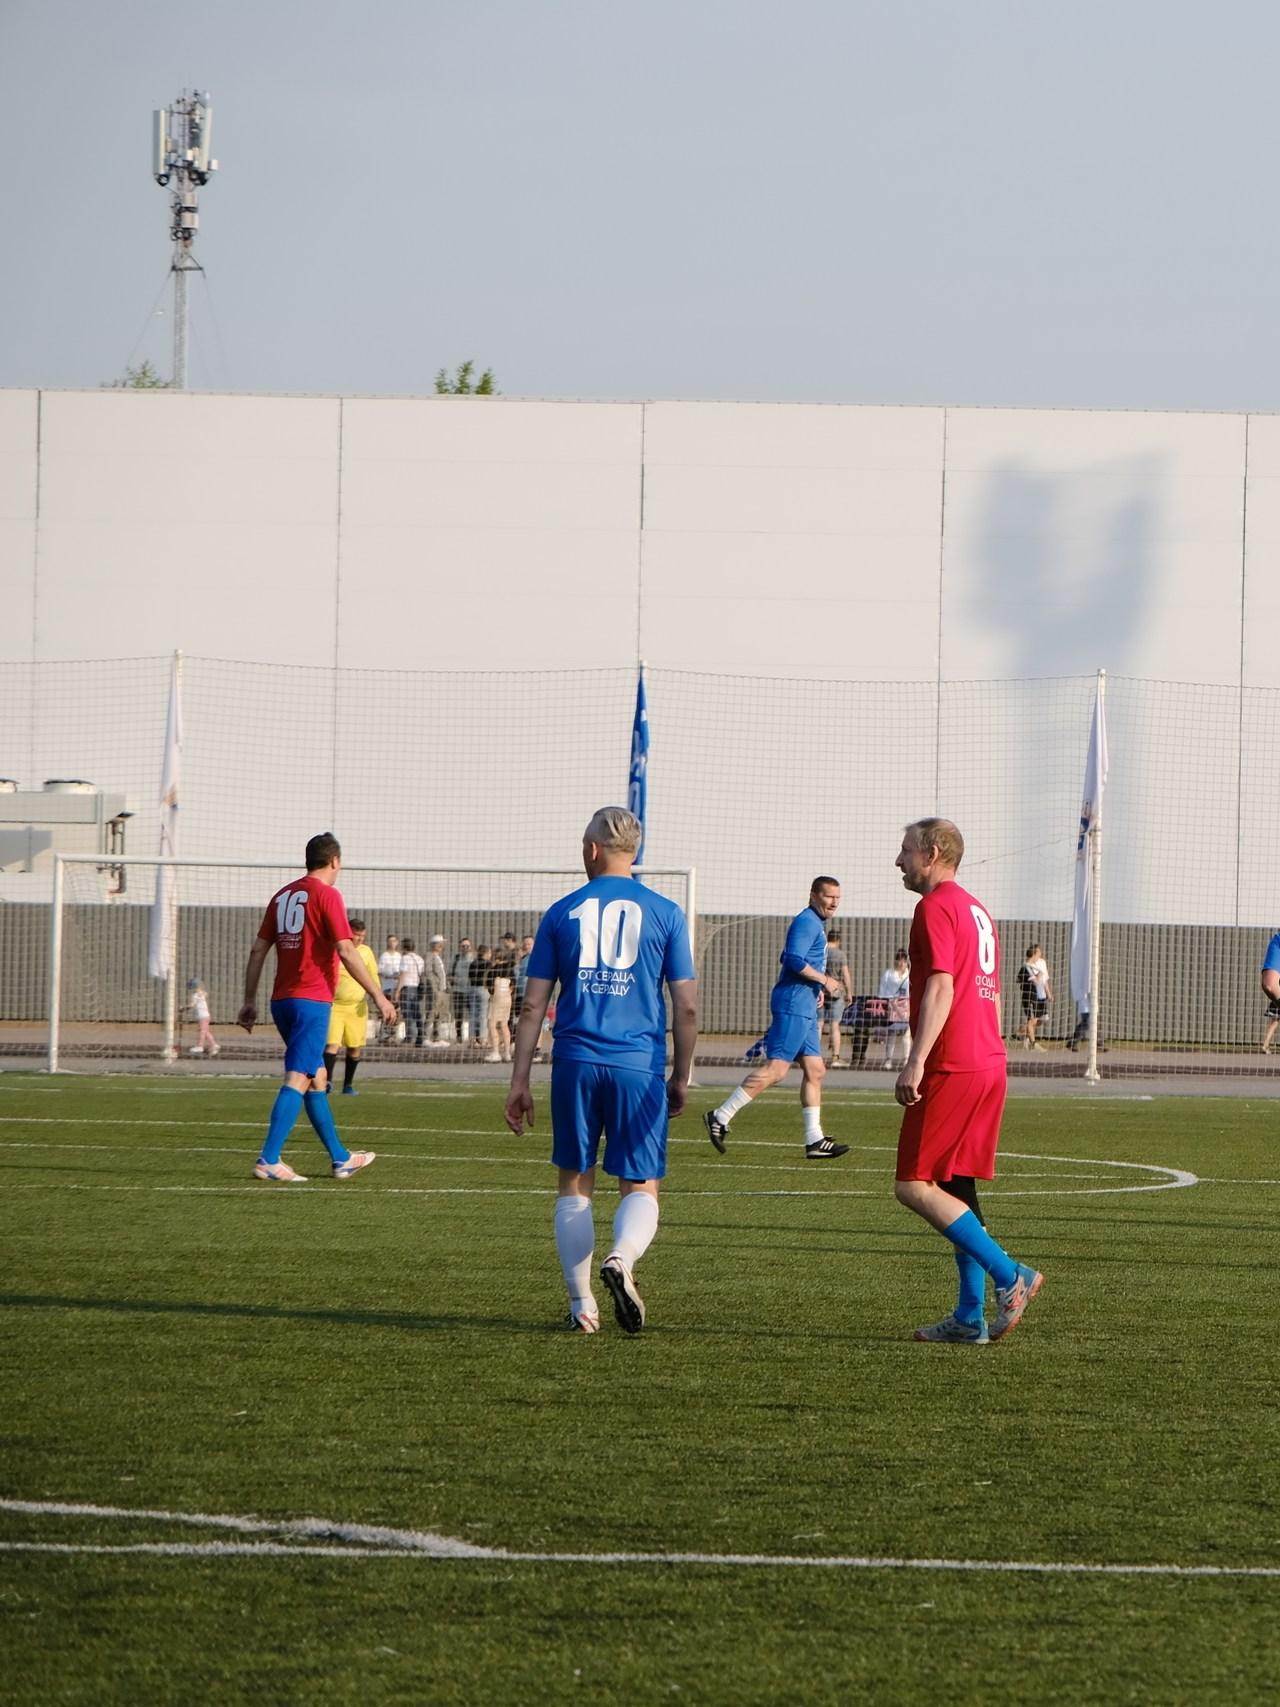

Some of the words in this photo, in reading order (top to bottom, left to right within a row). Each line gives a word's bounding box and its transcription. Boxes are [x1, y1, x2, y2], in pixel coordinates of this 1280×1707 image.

[275, 889, 309, 934] 16
[569, 897, 643, 970] 10
[970, 904, 995, 975] 8
[578, 969, 593, 981] ОТ
[582, 983, 590, 993] К
[591, 983, 630, 997] СЕРДЦУ
